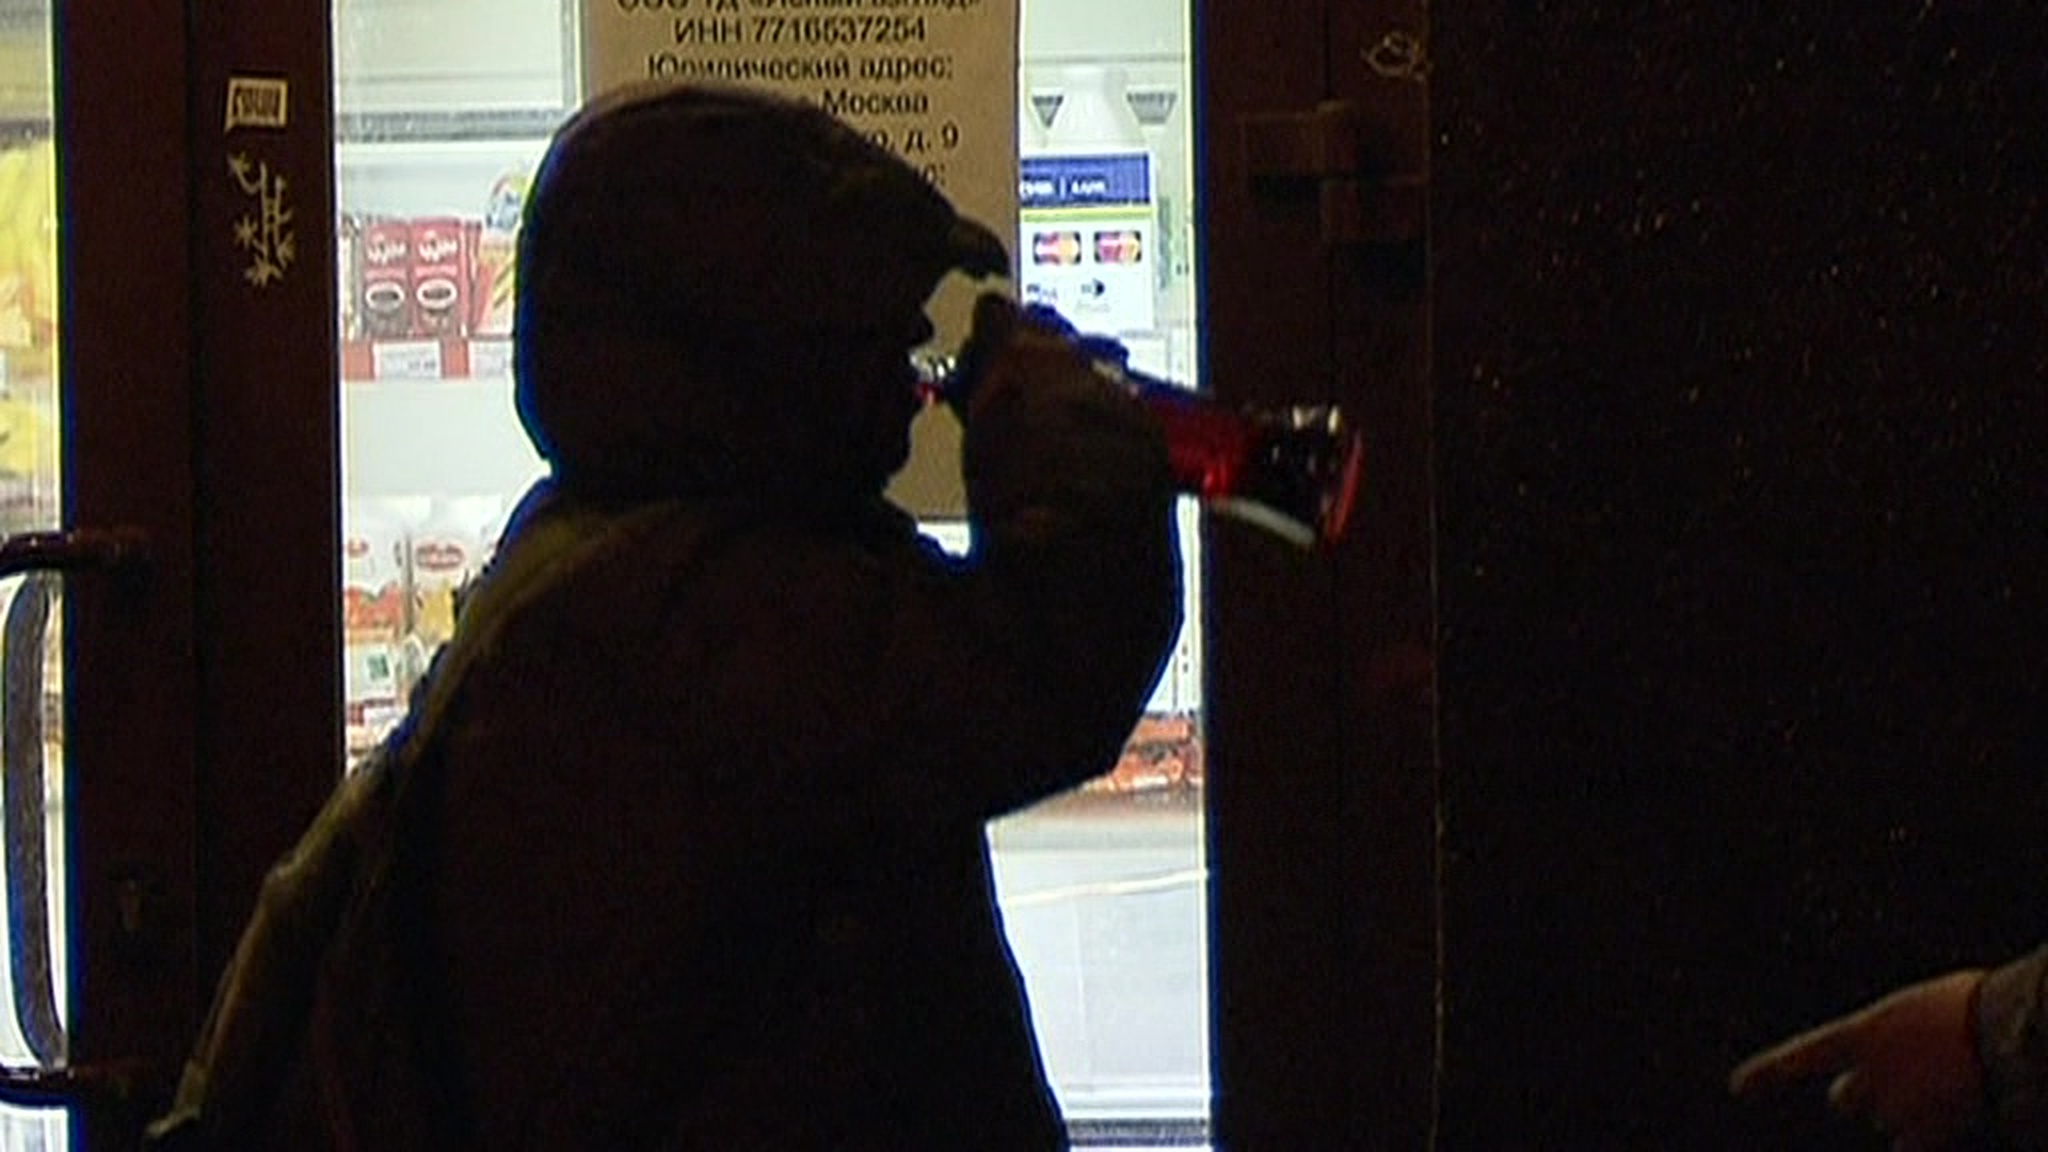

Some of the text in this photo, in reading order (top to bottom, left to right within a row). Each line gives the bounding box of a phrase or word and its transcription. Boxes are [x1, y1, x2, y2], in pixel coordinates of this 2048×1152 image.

[673, 16, 927, 43] ИНН 7716537254
[859, 55, 954, 82] адрес:
[942, 121, 959, 148] 9
